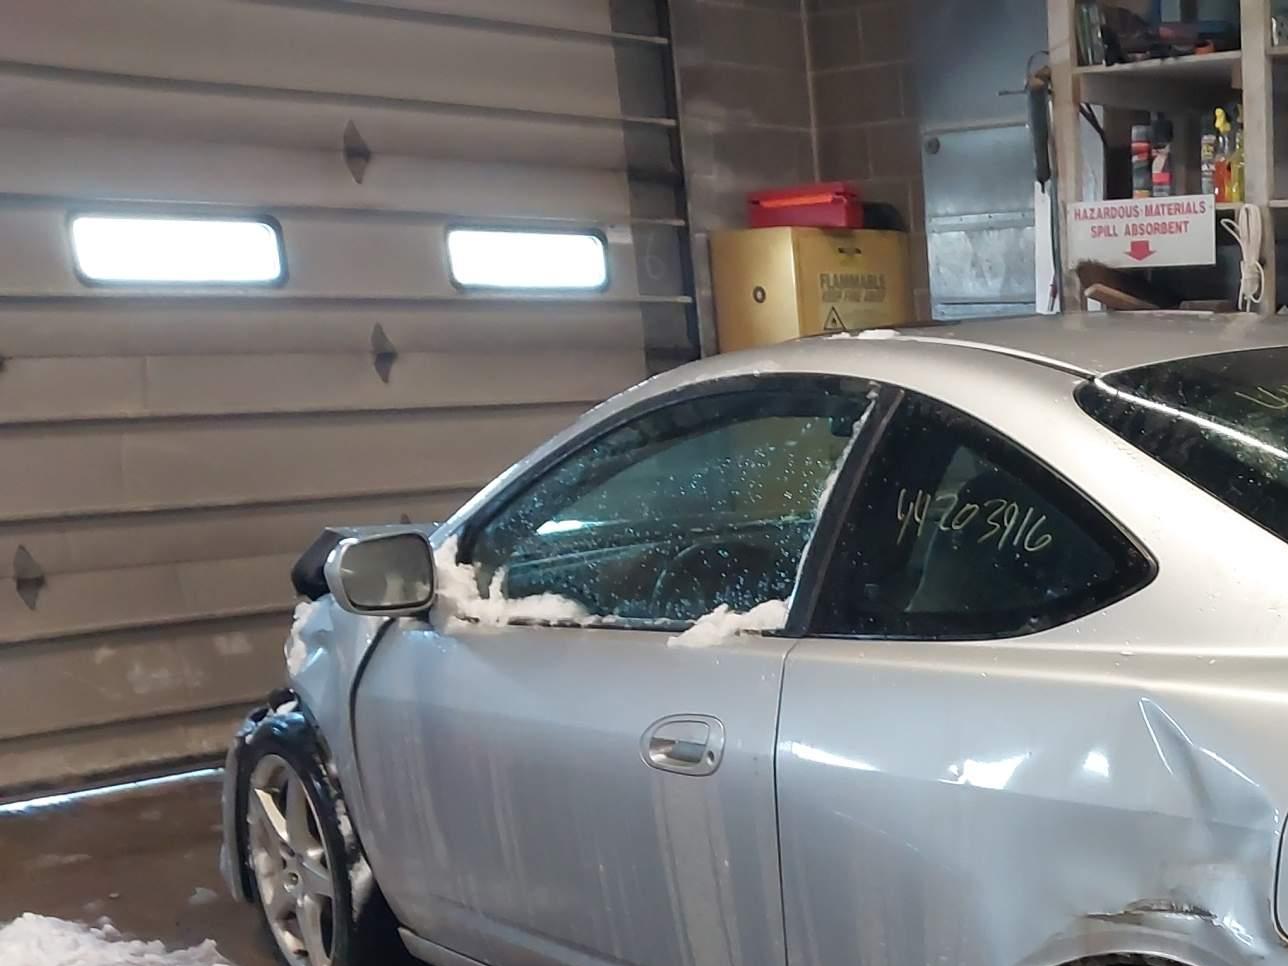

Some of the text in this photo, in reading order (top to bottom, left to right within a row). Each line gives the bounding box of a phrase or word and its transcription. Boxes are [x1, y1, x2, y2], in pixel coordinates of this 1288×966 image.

[1074, 201, 1207, 221] HAZARDOUS MATERIALS
[1090, 221, 1190, 239] SPILL ABSORBENT
[819, 273, 886, 290] FLAMMABLE
[897, 487, 1052, 551] 44203916
